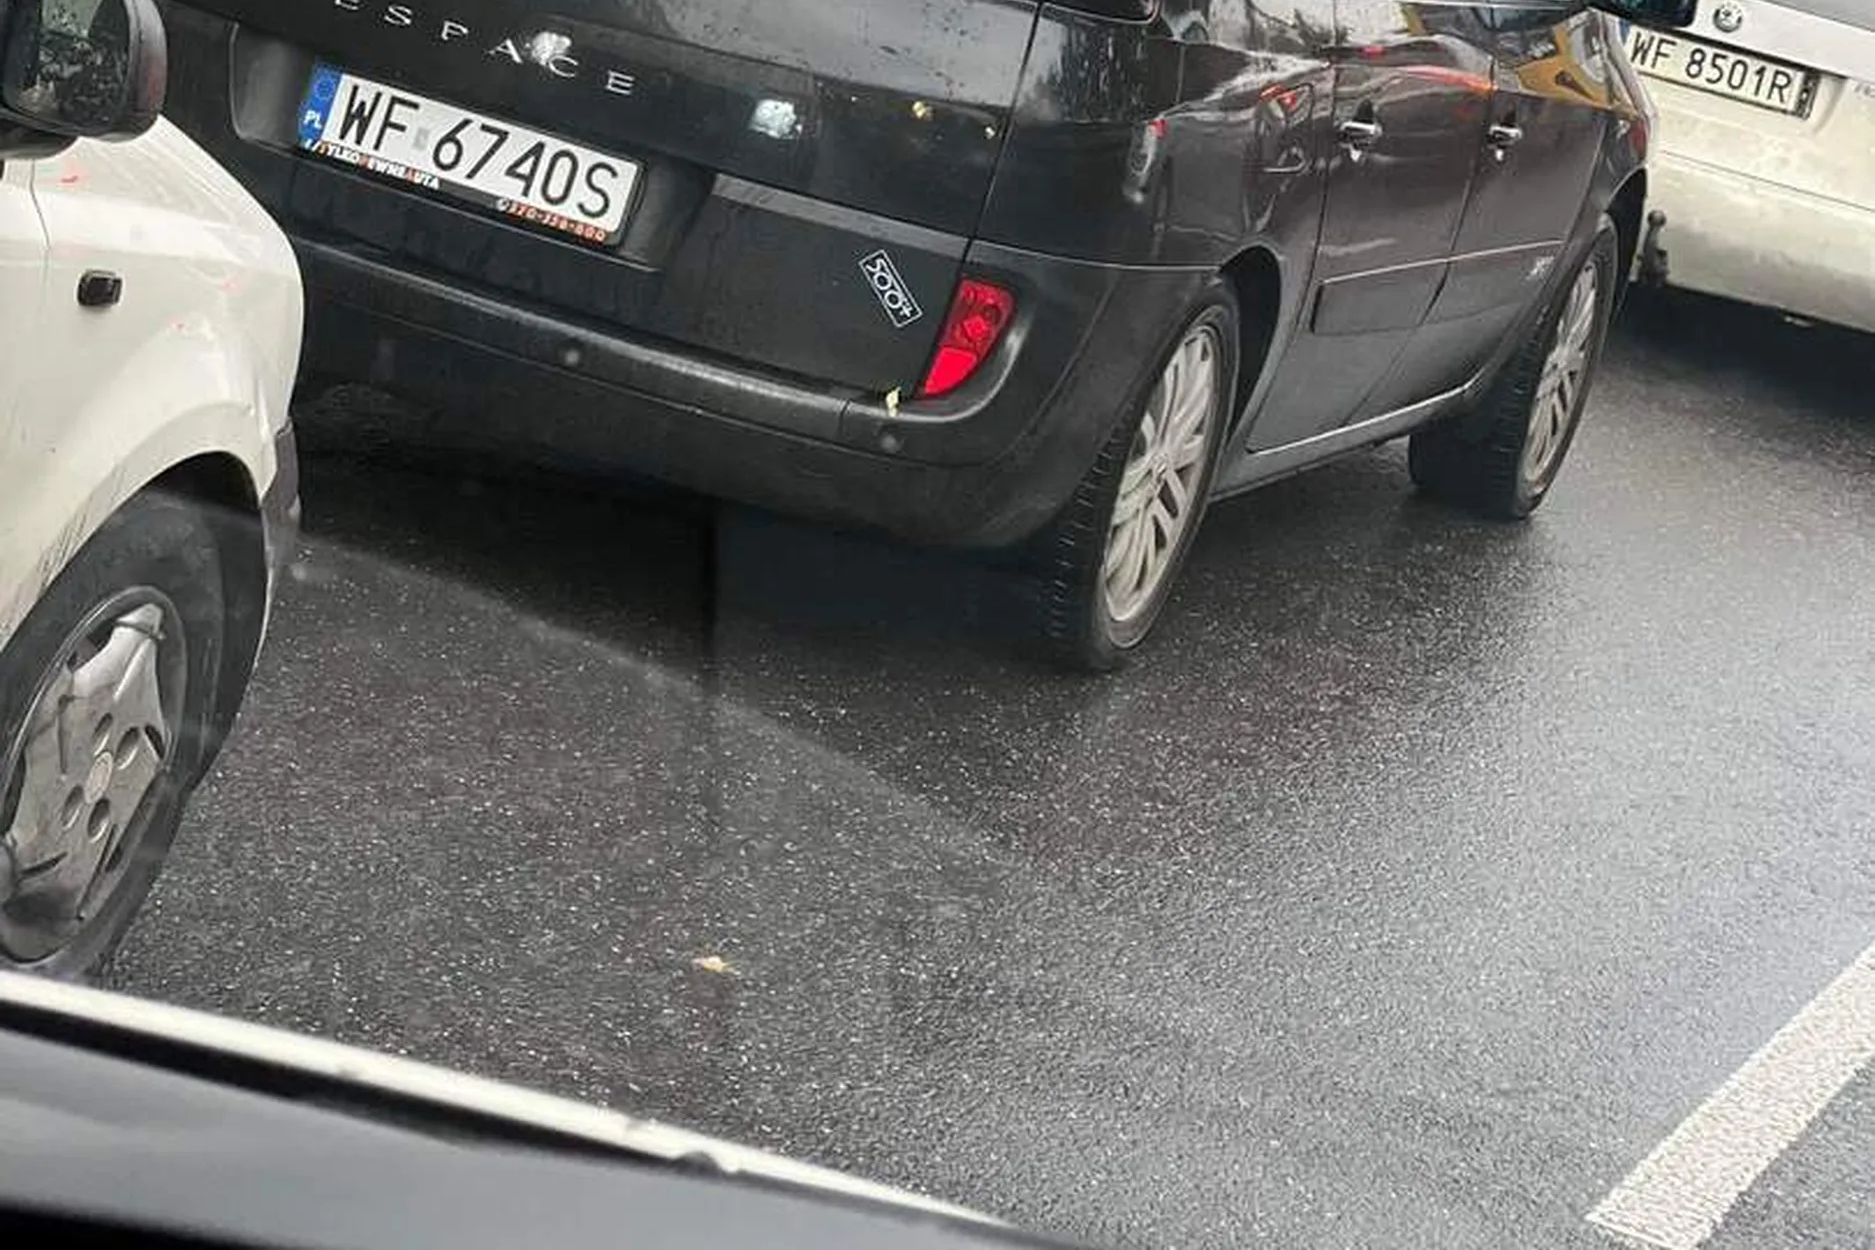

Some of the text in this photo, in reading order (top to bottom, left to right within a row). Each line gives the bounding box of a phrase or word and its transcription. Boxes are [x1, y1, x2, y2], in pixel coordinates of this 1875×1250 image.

[1629, 32, 1792, 105] WF 8501R
[303, 109, 323, 130] PL
[338, 82, 619, 220] WF 6740S
